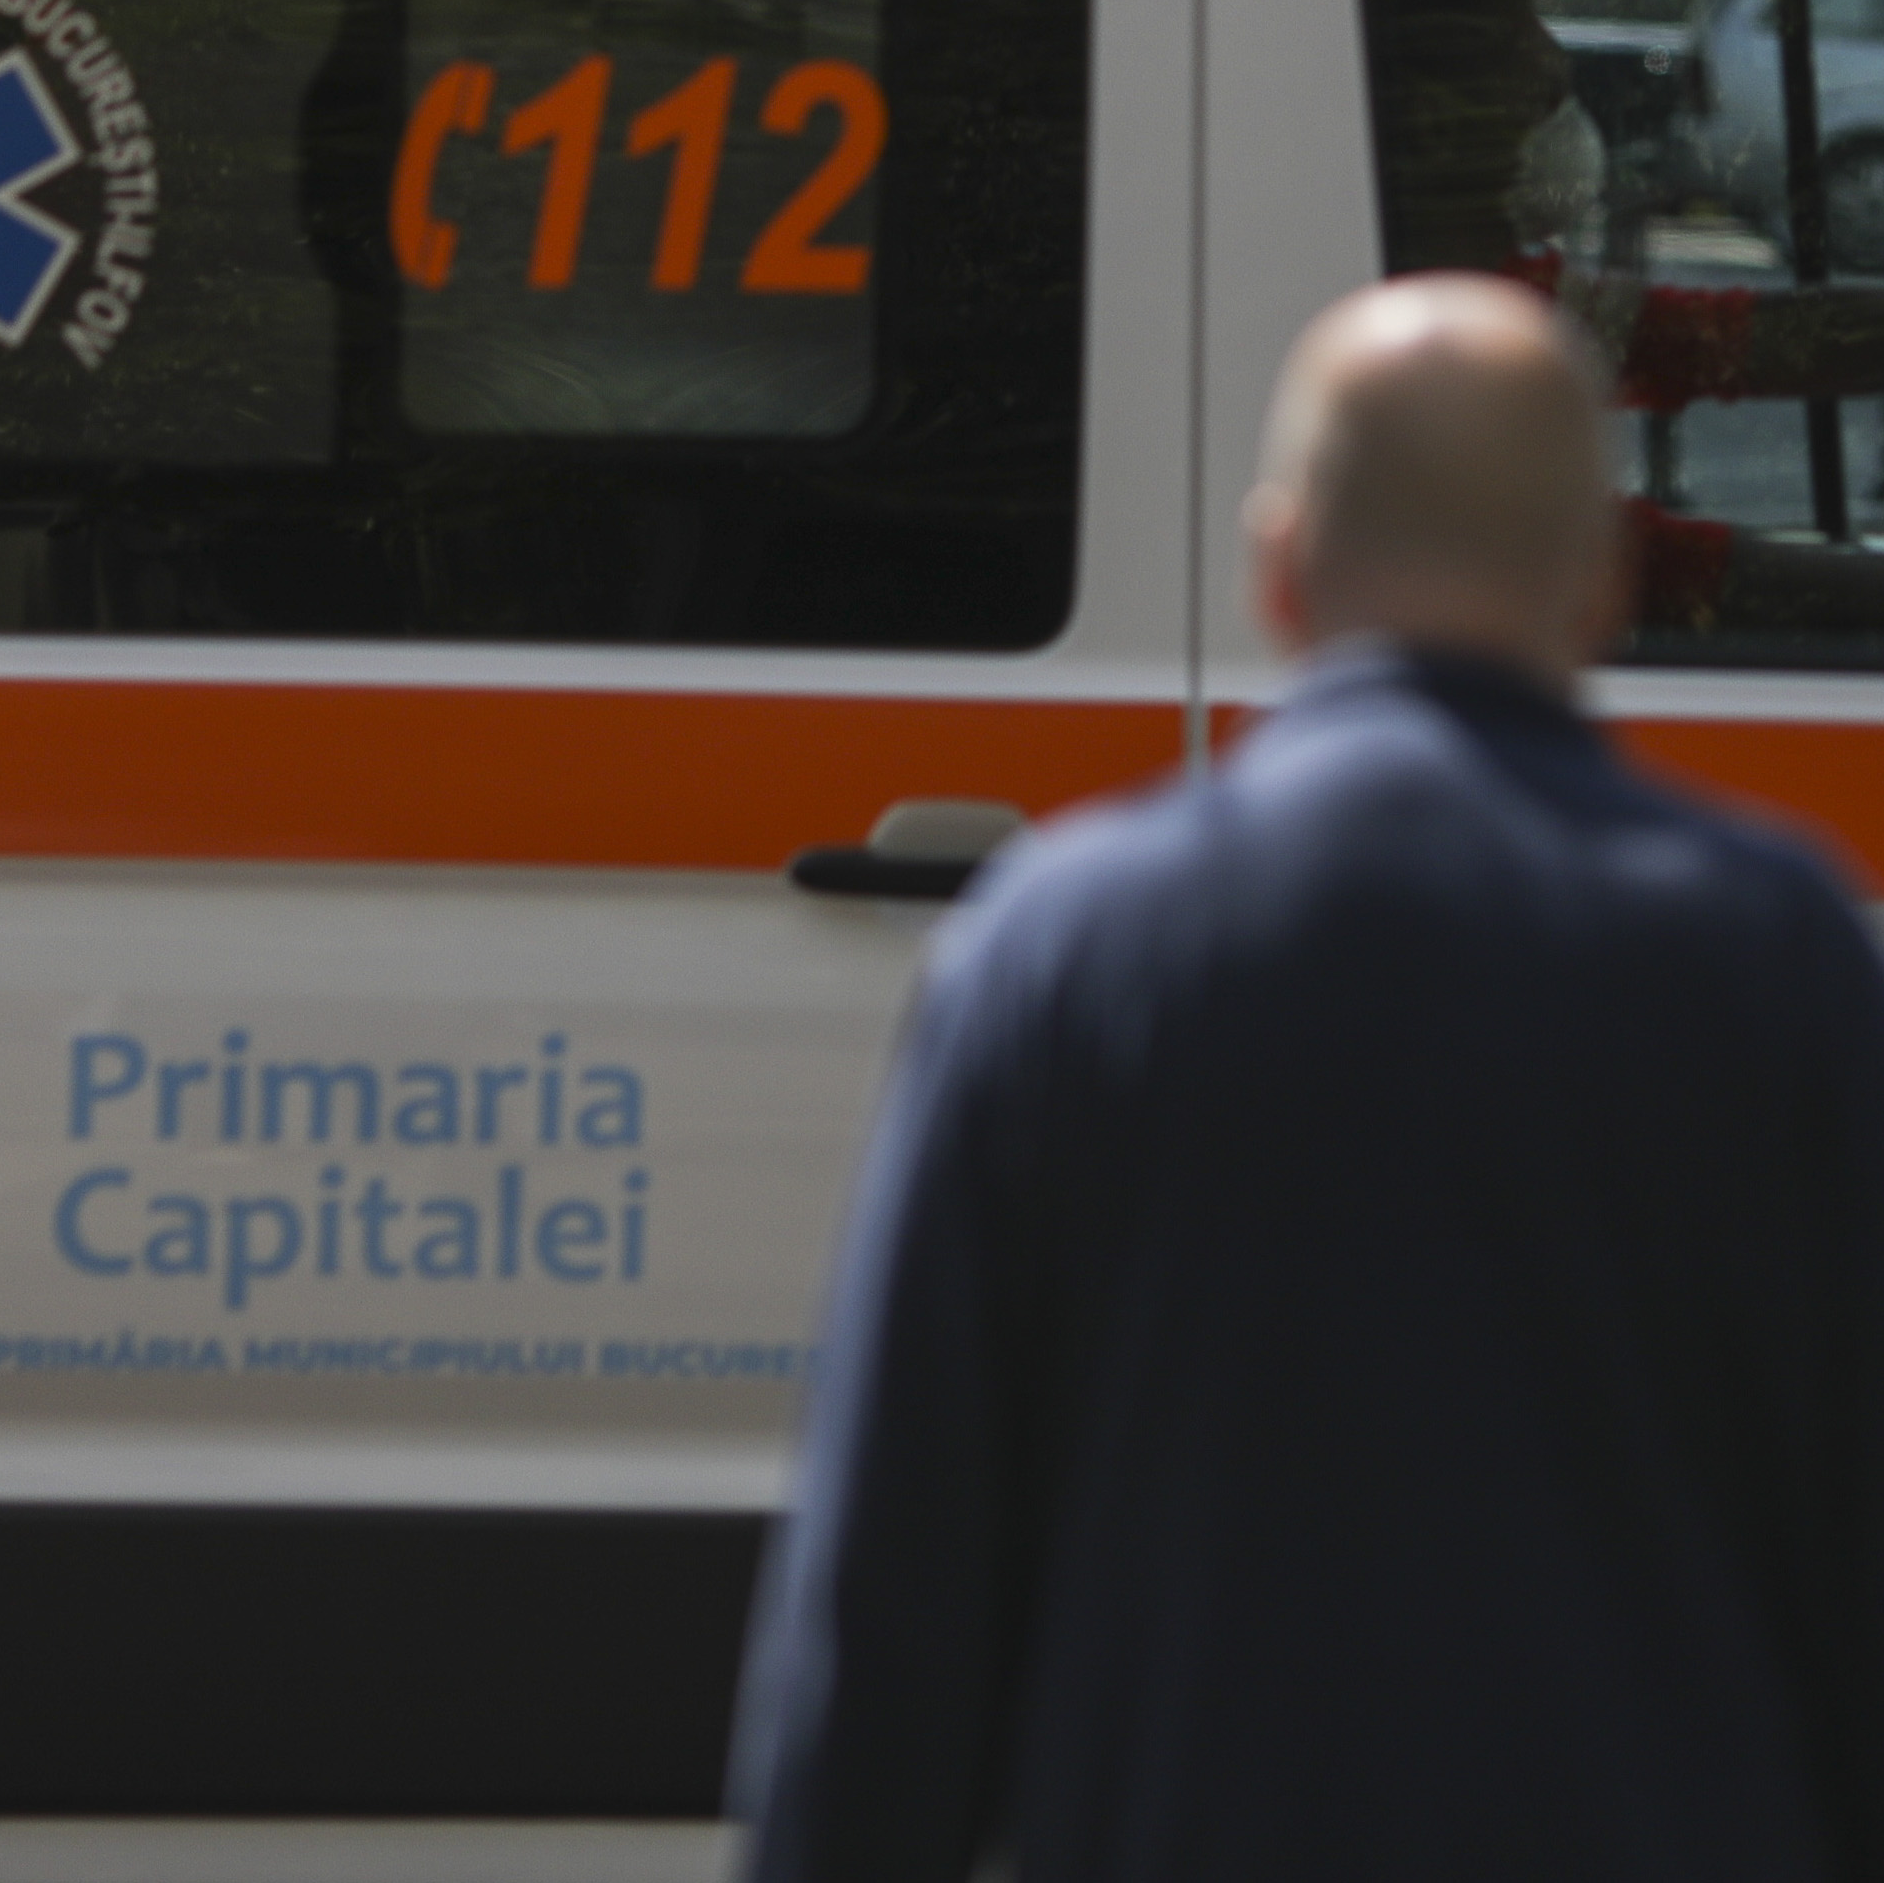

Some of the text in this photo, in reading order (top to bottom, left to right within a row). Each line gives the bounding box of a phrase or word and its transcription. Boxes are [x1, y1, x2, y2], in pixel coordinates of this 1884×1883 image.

[498, 52, 890, 294] 112
[67, 1028, 646, 1150] Primaria
[53, 1166, 650, 1312] Capitalei
